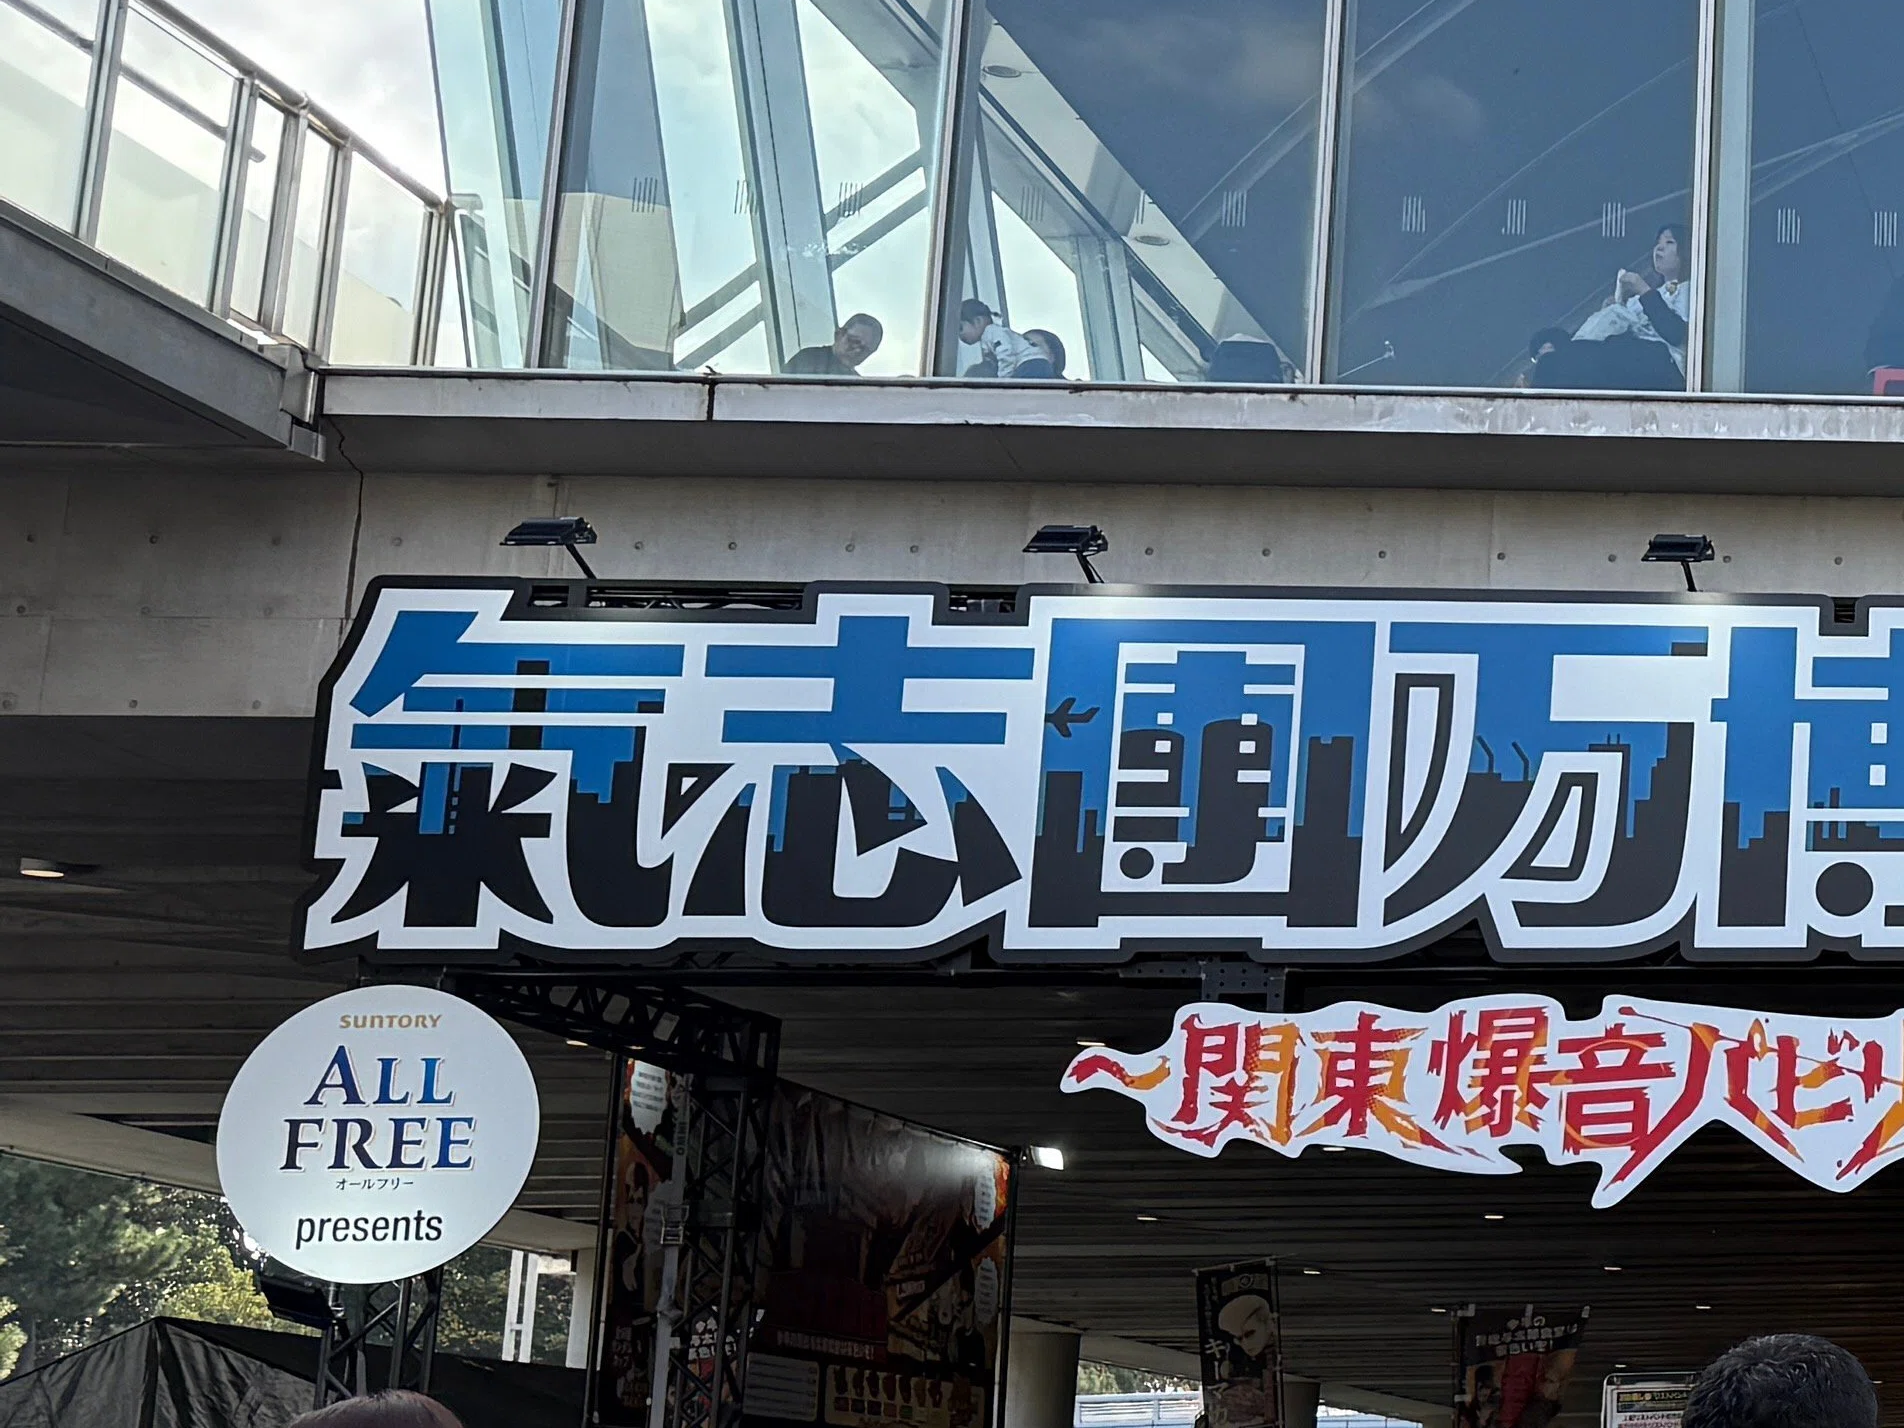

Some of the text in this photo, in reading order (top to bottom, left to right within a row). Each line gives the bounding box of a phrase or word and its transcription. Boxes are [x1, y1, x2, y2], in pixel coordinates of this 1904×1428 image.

[339, 1014, 442, 1029] SUNTORY
[303, 1044, 457, 1107] ALL
[279, 1116, 476, 1172] FREE
[335, 1177, 414, 1191] オールフリー
[296, 1210, 443, 1250] presents
